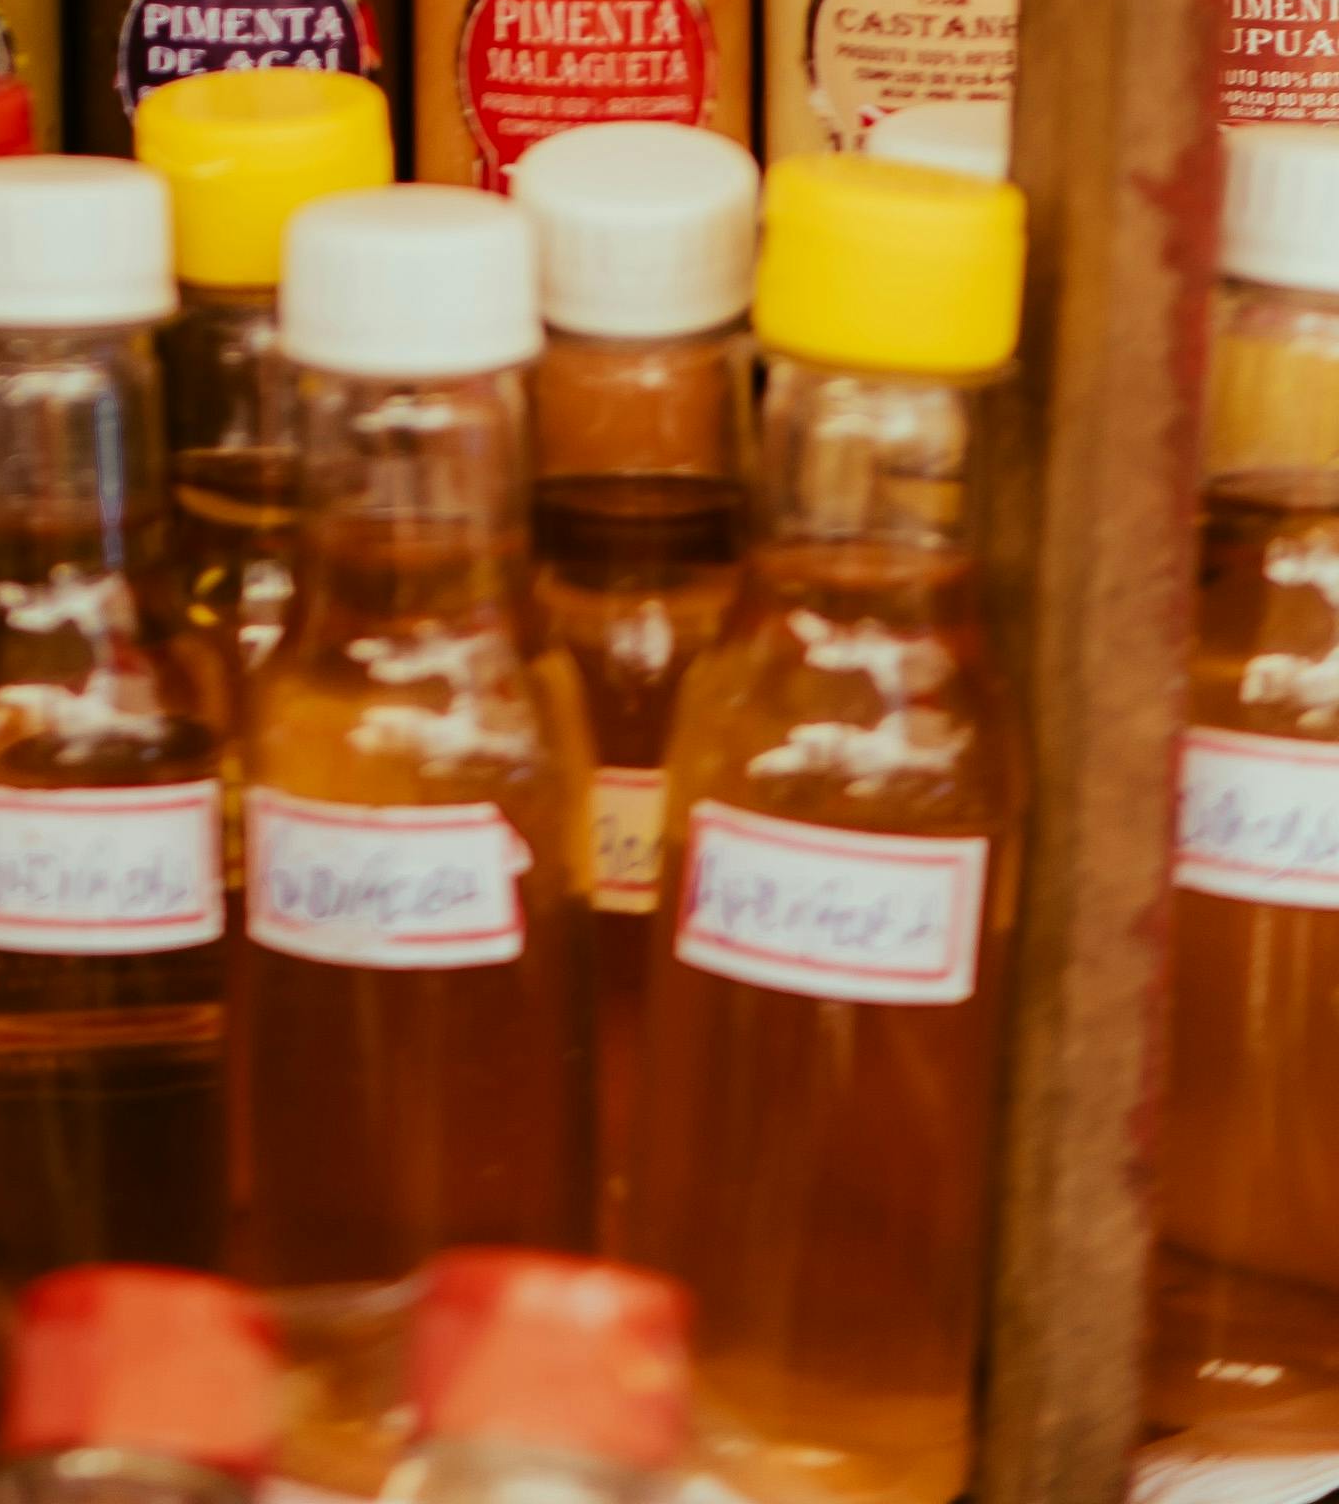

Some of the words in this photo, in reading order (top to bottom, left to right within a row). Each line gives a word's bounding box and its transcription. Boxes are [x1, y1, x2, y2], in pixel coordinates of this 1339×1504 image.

[144, 3, 345, 44] PIMENTA
[147, 45, 209, 74] DE
[485, 47, 689, 88] MALAGUETA
